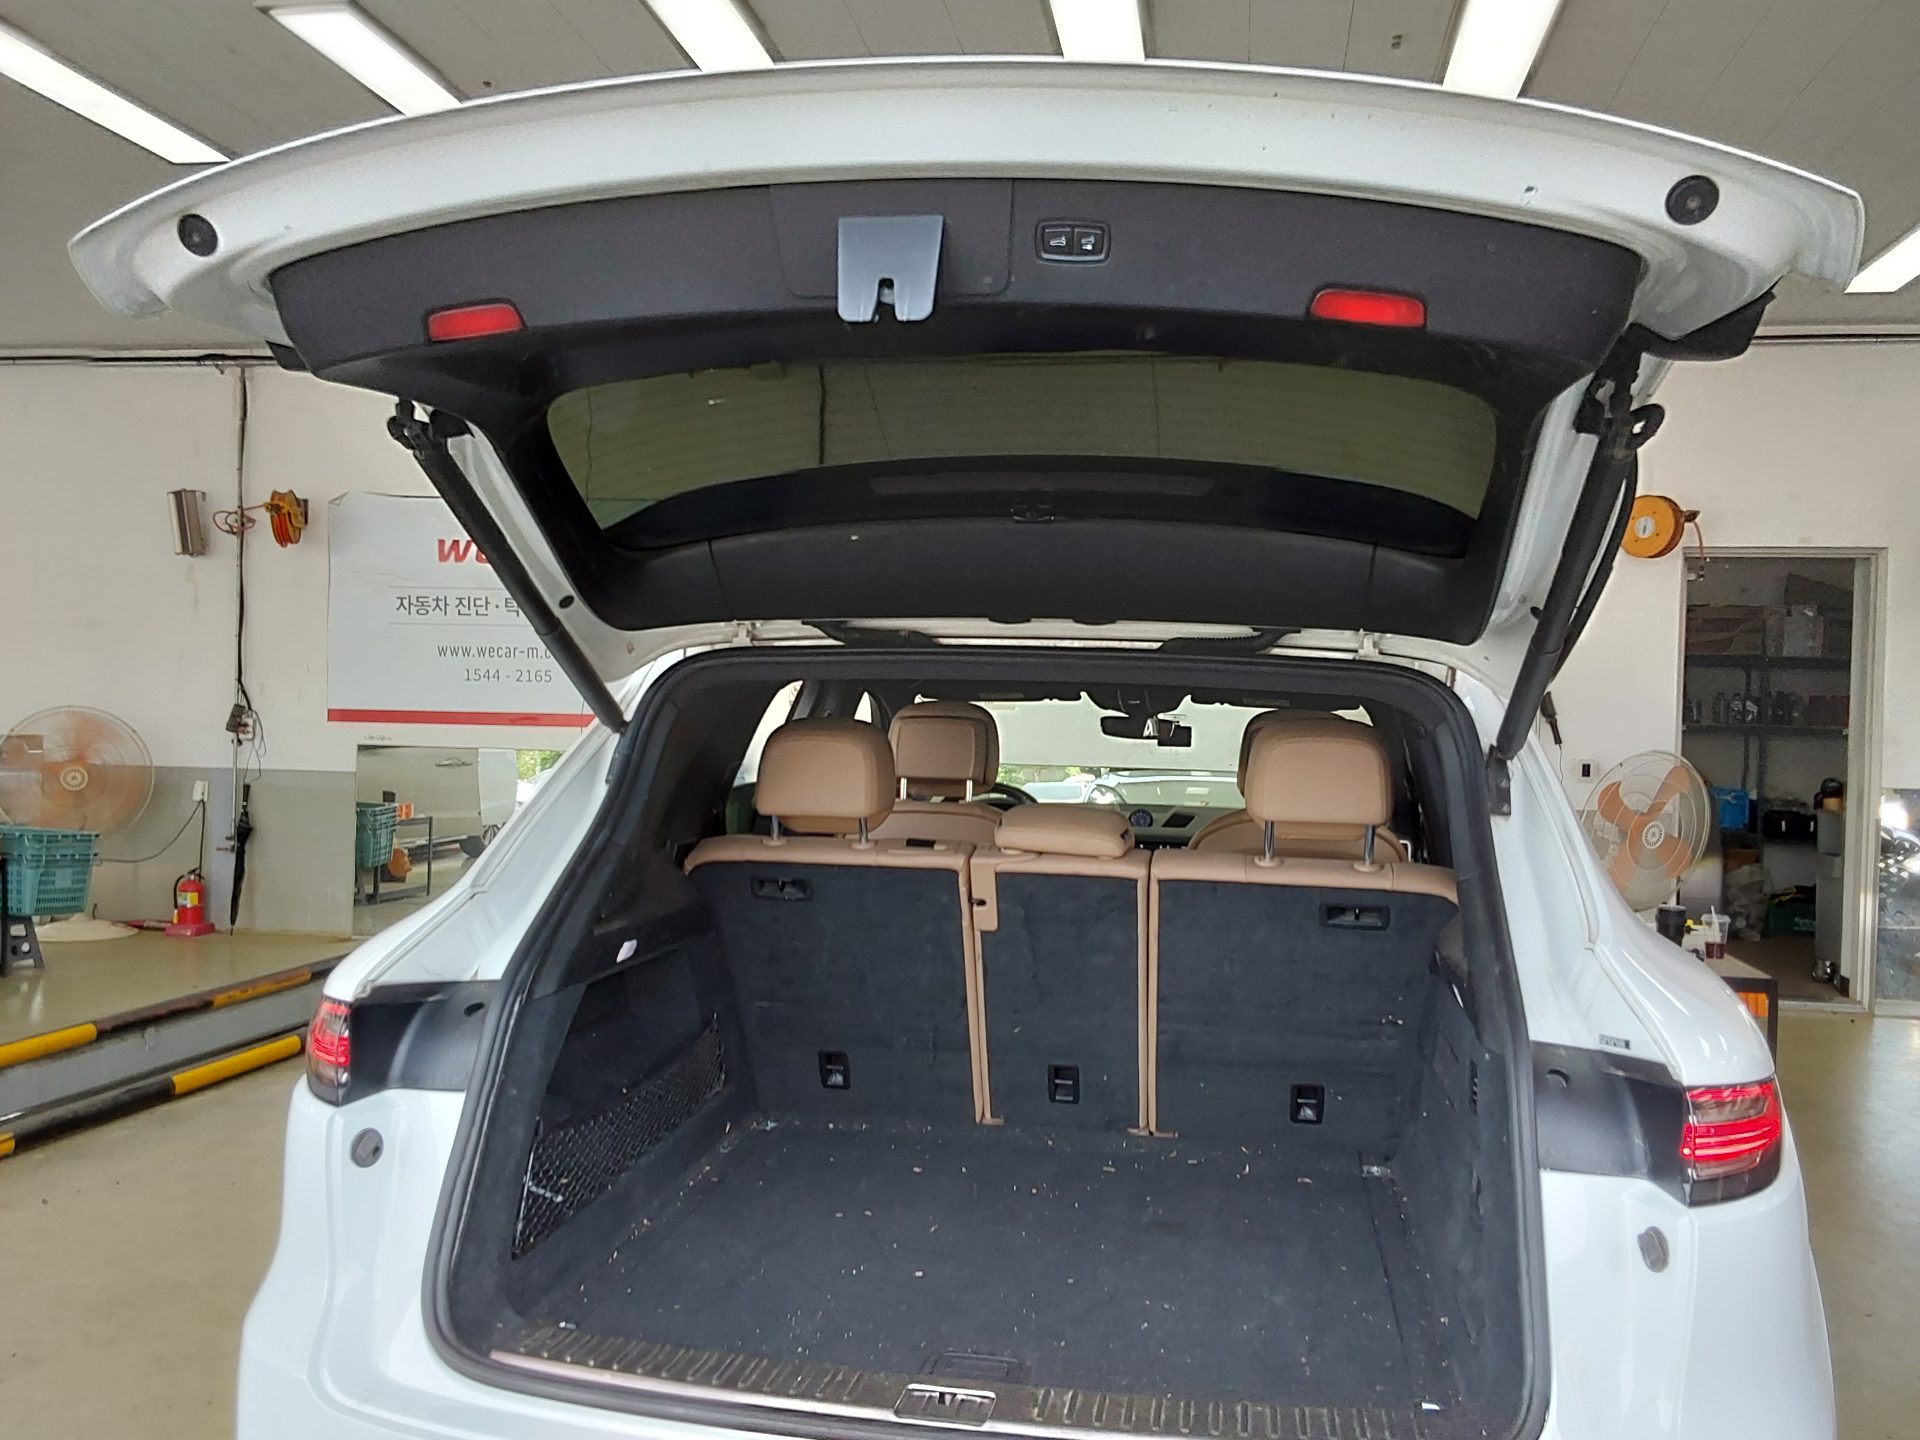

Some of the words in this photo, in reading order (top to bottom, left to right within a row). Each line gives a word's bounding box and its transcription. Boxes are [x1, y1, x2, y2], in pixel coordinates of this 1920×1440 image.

[396, 595, 450, 616] 자동차
[464, 668, 500, 682] 1544
[515, 669, 552, 683] 2165
